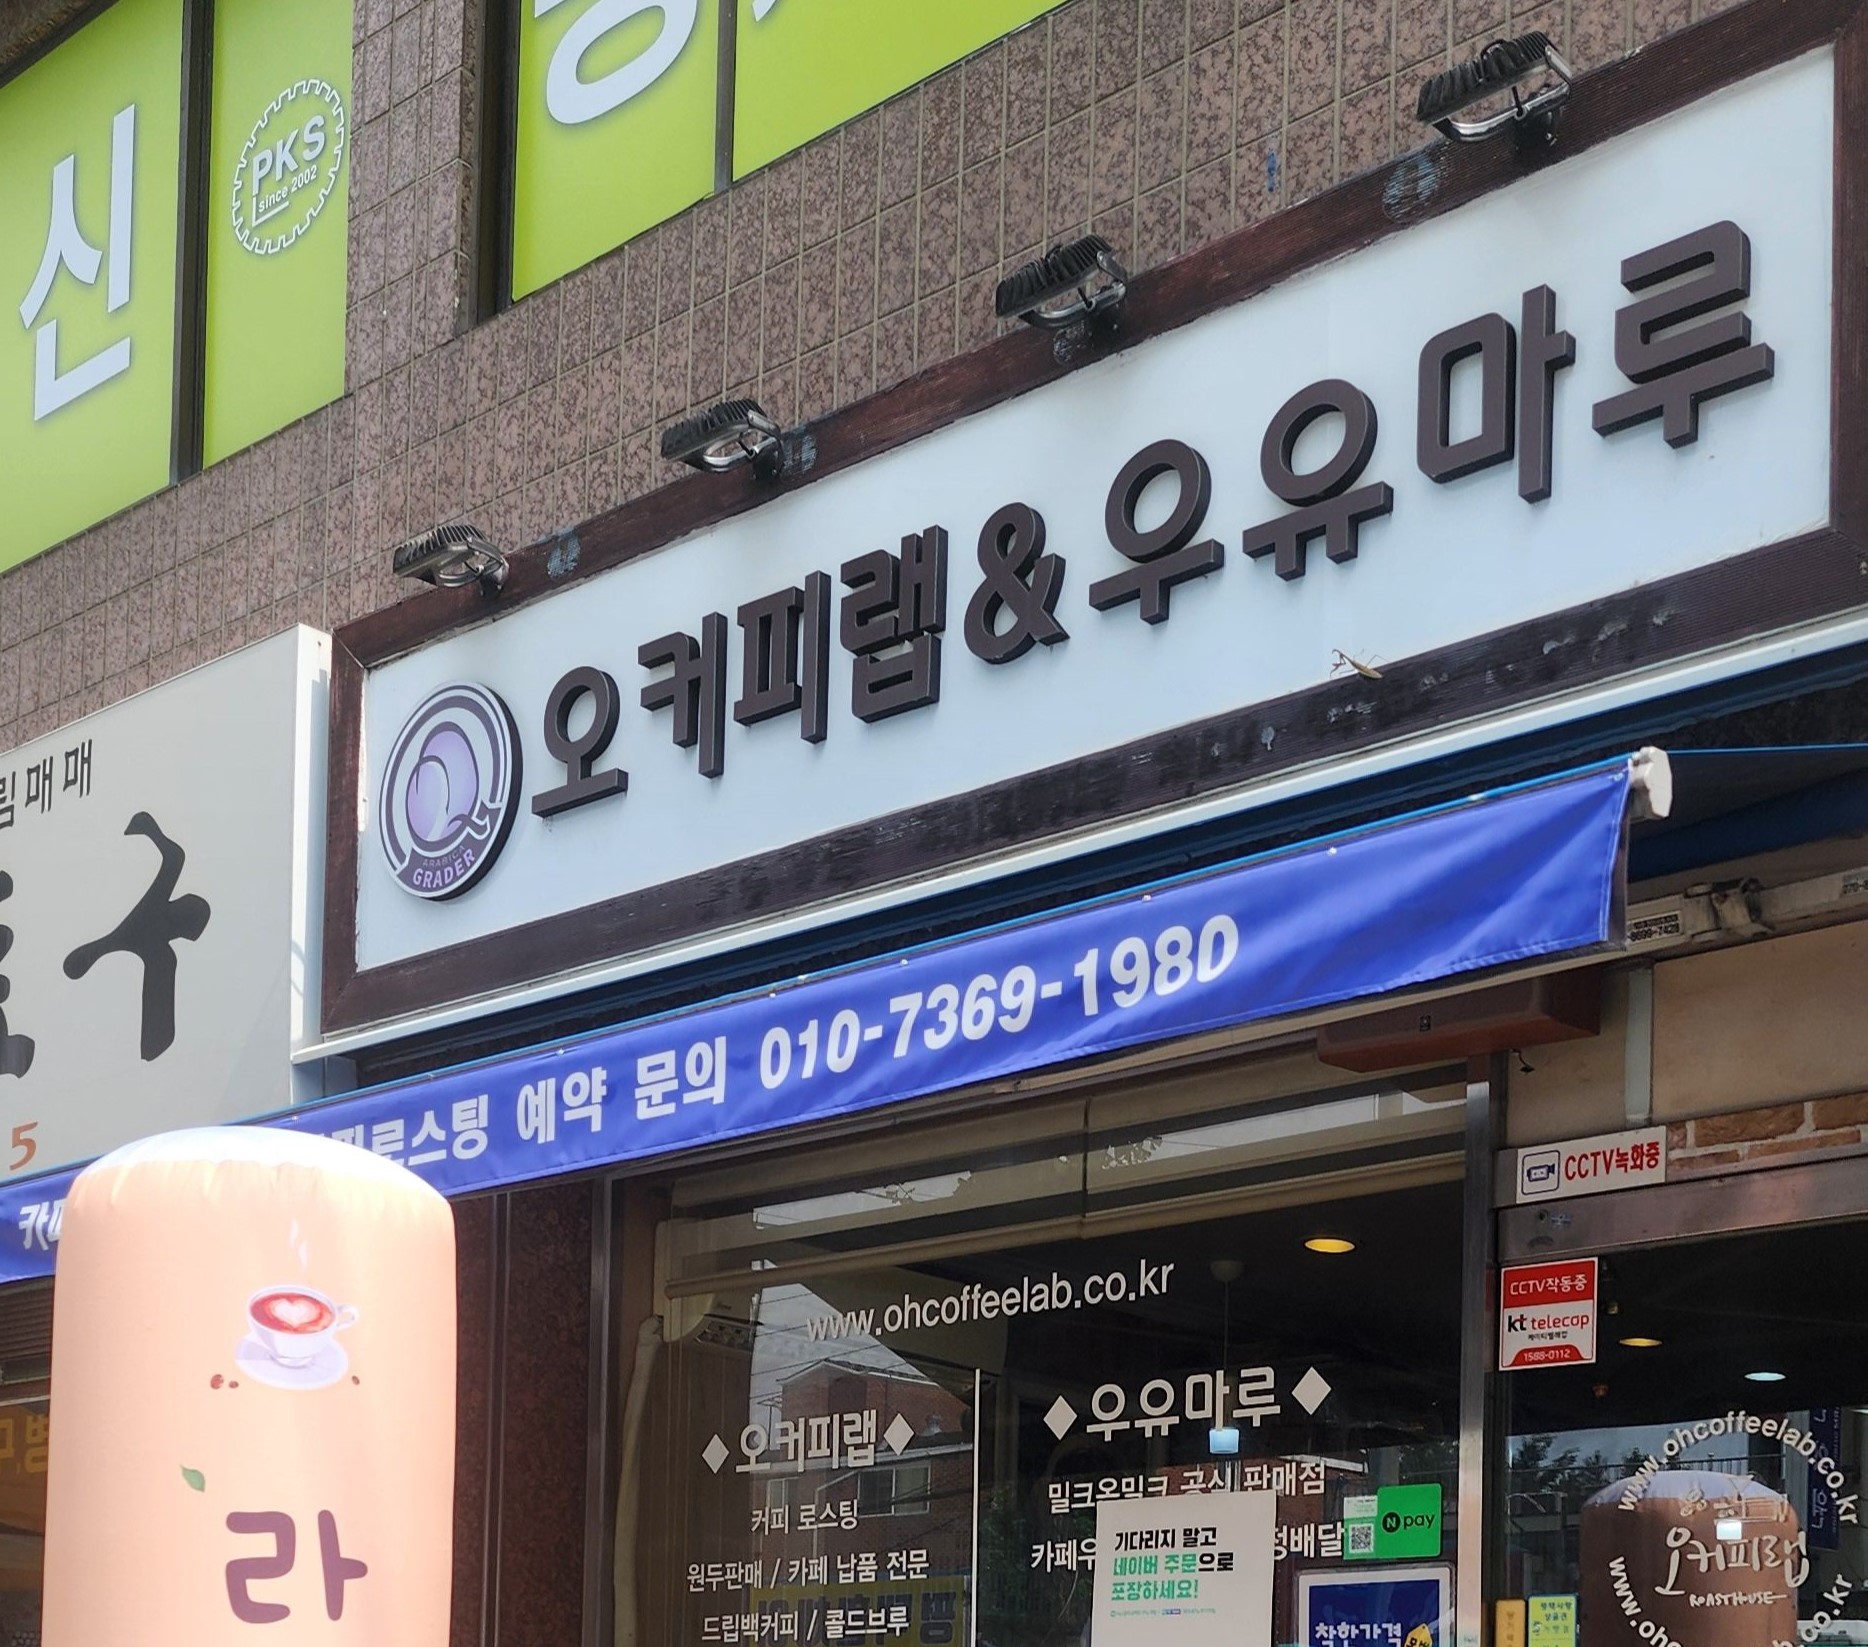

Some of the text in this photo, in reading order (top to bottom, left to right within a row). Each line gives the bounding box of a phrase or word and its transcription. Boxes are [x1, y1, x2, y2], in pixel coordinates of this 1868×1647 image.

[253, 115, 325, 196] PKS
[259, 164, 317, 212] since 2002
[20, 103, 136, 422] 신
[413, 848, 475, 888] GRADER
[516, 1069, 607, 1144] 예약
[634, 1035, 727, 1121] 문의
[759, 913, 1239, 1091] 010-7369-1980
[1565, 1141, 1660, 1181] CCTV녹화중
[807, 1259, 1175, 1342] www.ohcoffeelab.co.kr
[1510, 1273, 1588, 1296] CCTV작동중
[1507, 1312, 1590, 1333] kt telecop
[1523, 1348, 1571, 1363] 1588-0112
[1086, 1366, 1281, 1442] 우유마루
[735, 1409, 878, 1474] 오커피랩
[1243, 1460, 1327, 1497] 판매점
[1617, 1410, 1860, 1526] www.ohcoffeelab.co.kr
[751, 1499, 859, 1536] 커피 로스팅
[1403, 1514, 1436, 1530] pay
[1115, 1526, 1217, 1551] 기다리지 말고
[687, 1560, 763, 1593] 원두판매
[788, 1554, 829, 1586] 카페
[836, 1552, 878, 1584] 납품
[887, 1549, 930, 1581] 전문
[1113, 1552, 1234, 1576] 네이버 주문으로
[1111, 1579, 1199, 1601] 포장하세요!
[701, 1609, 799, 1643] 드립백커피
[824, 1606, 910, 1639] 콜드브루
